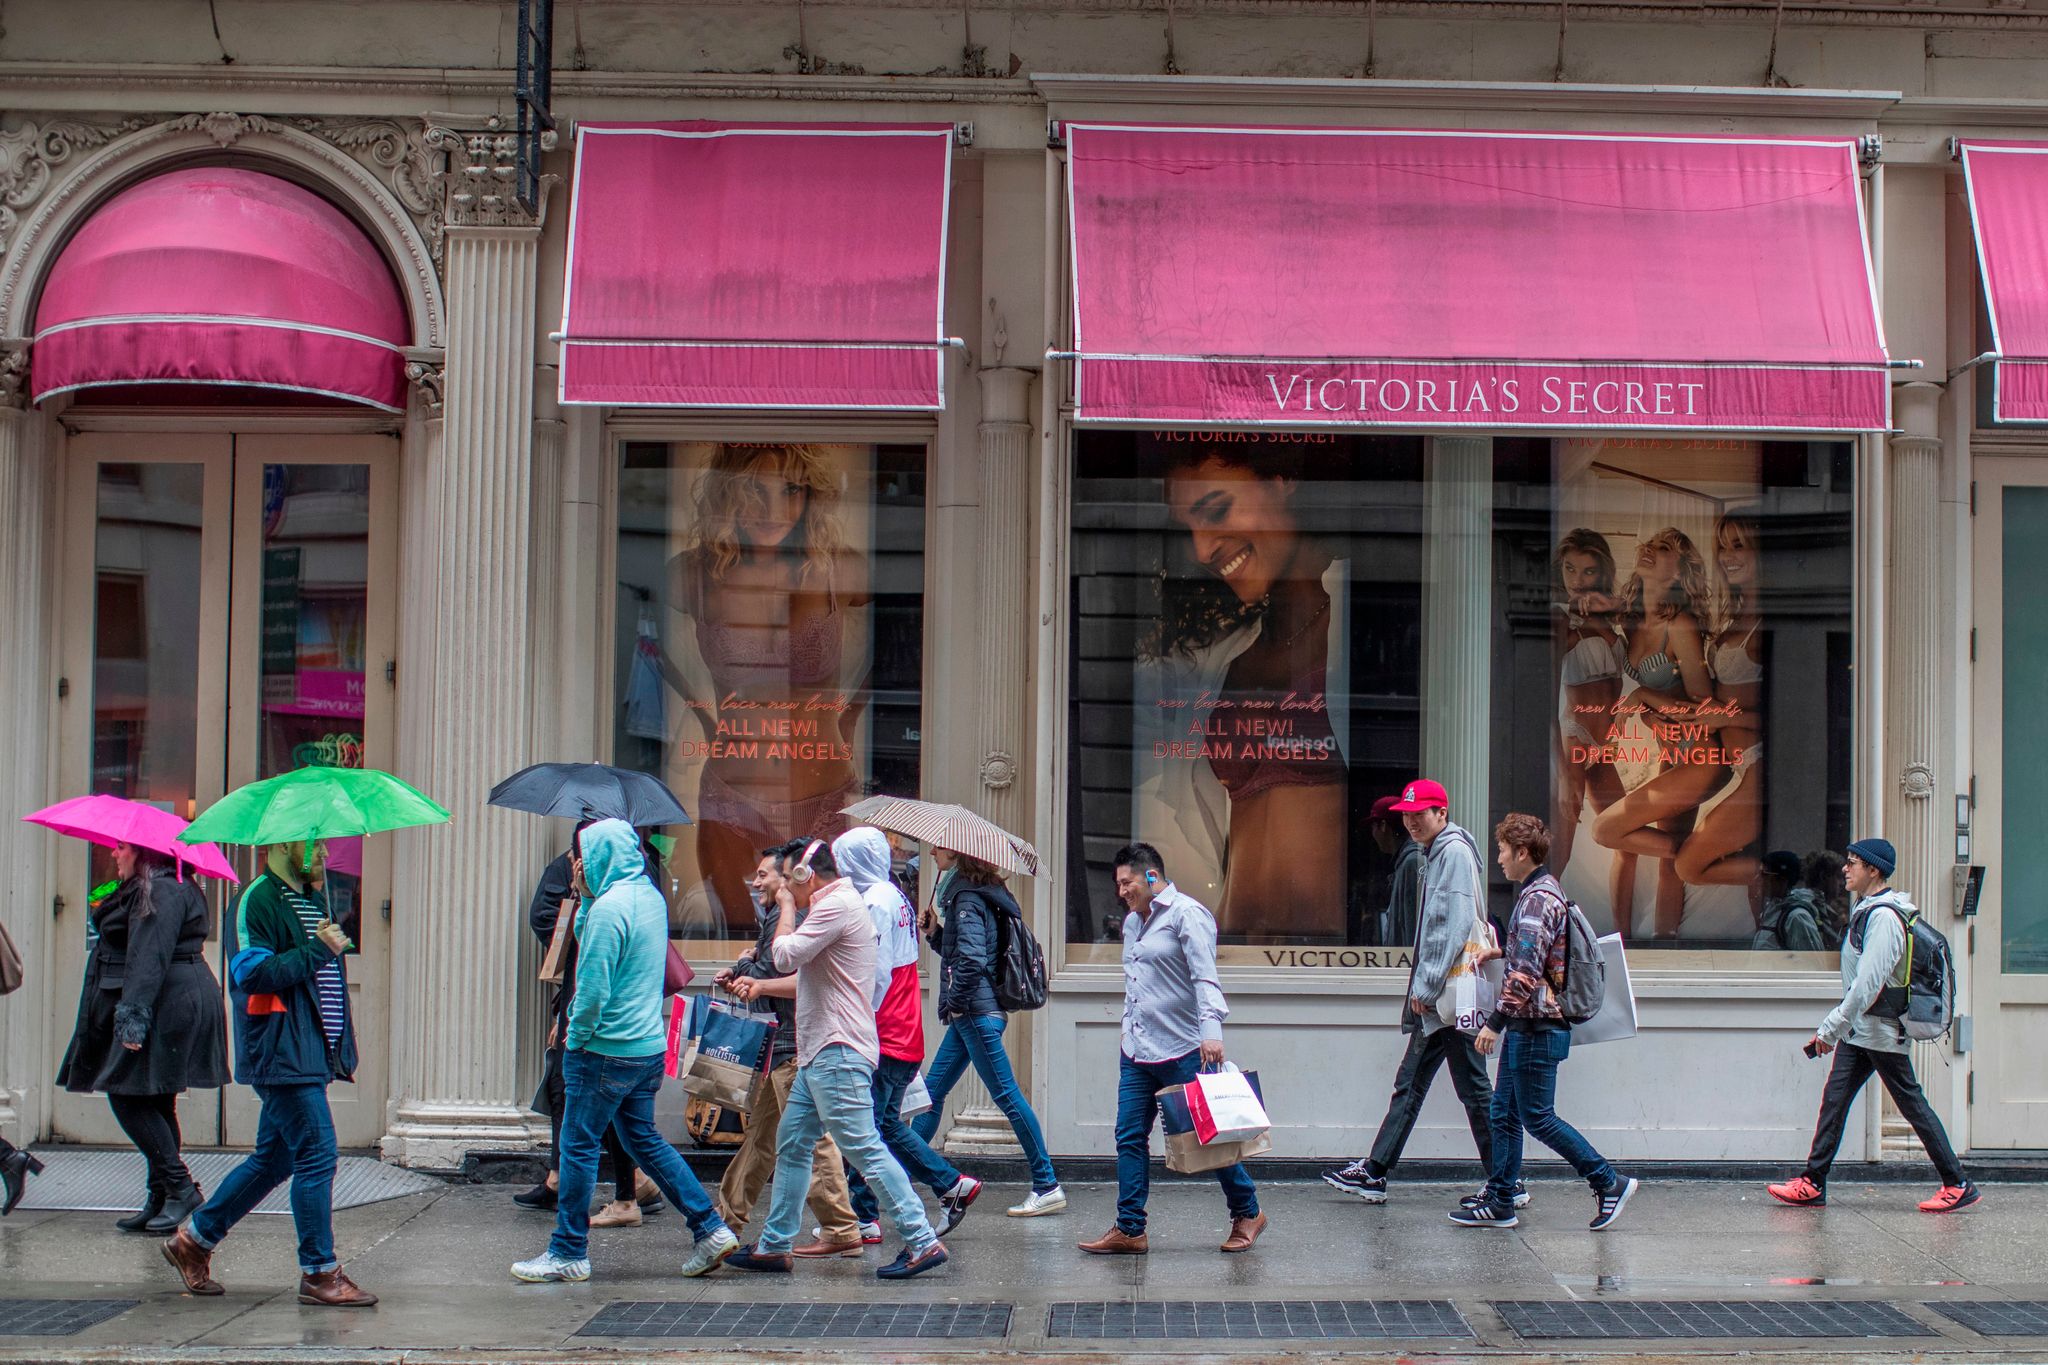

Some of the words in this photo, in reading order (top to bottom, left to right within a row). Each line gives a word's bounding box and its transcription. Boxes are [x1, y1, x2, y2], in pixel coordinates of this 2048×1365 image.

[1265, 374, 1519, 413] VICTORIA'S
[1541, 376, 1704, 415] SECRET
[715, 718, 754, 736] ALL
[761, 718, 818, 737] NEW!
[1188, 718, 1229, 736] ALL
[1235, 718, 1294, 737] NEW!
[1605, 723, 1644, 741] ALL
[1651, 723, 1710, 742] NEW!
[682, 741, 759, 759] DREAM
[765, 742, 853, 761] ANGELS
[1153, 740, 1233, 760] DREAM
[1239, 742, 1330, 761] ANGELS
[1570, 746, 1649, 765] DREAM
[1656, 747, 1744, 766] ANGELS
[705, 1046, 741, 1064] HOLLISTER
